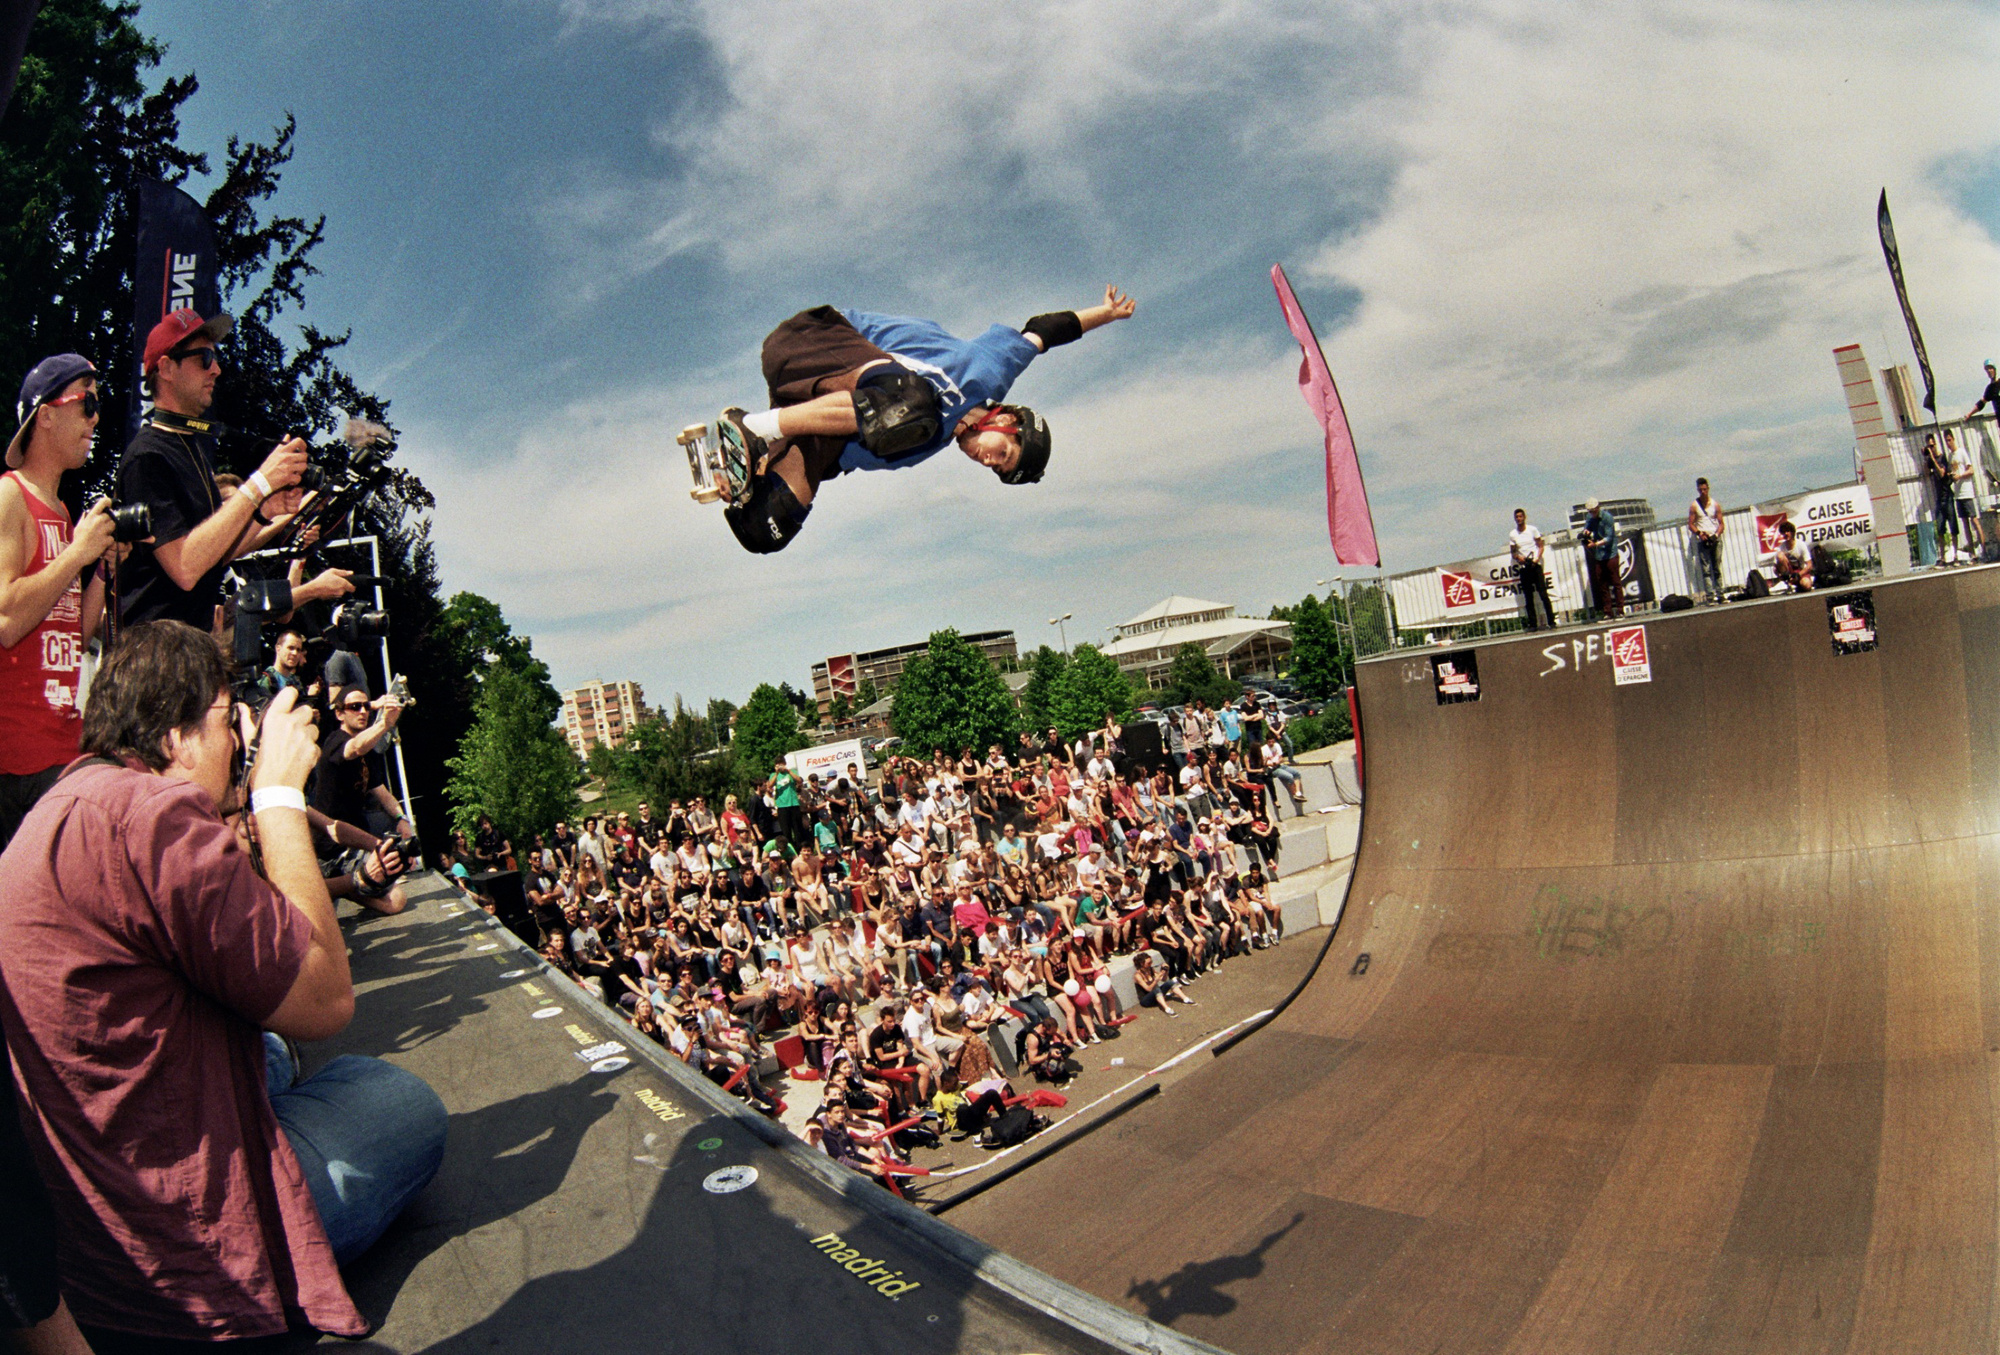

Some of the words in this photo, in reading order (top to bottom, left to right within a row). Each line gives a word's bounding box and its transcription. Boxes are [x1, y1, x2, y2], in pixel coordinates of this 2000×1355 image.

[1807, 500, 1855, 521] CAISSE
[1796, 519, 1872, 543] D'EPARGNE
[1489, 563, 1520, 581] CAIS
[1622, 665, 1642, 675] CAISSE
[634, 1088, 686, 1122] madrid
[809, 1232, 921, 1298] madrid
